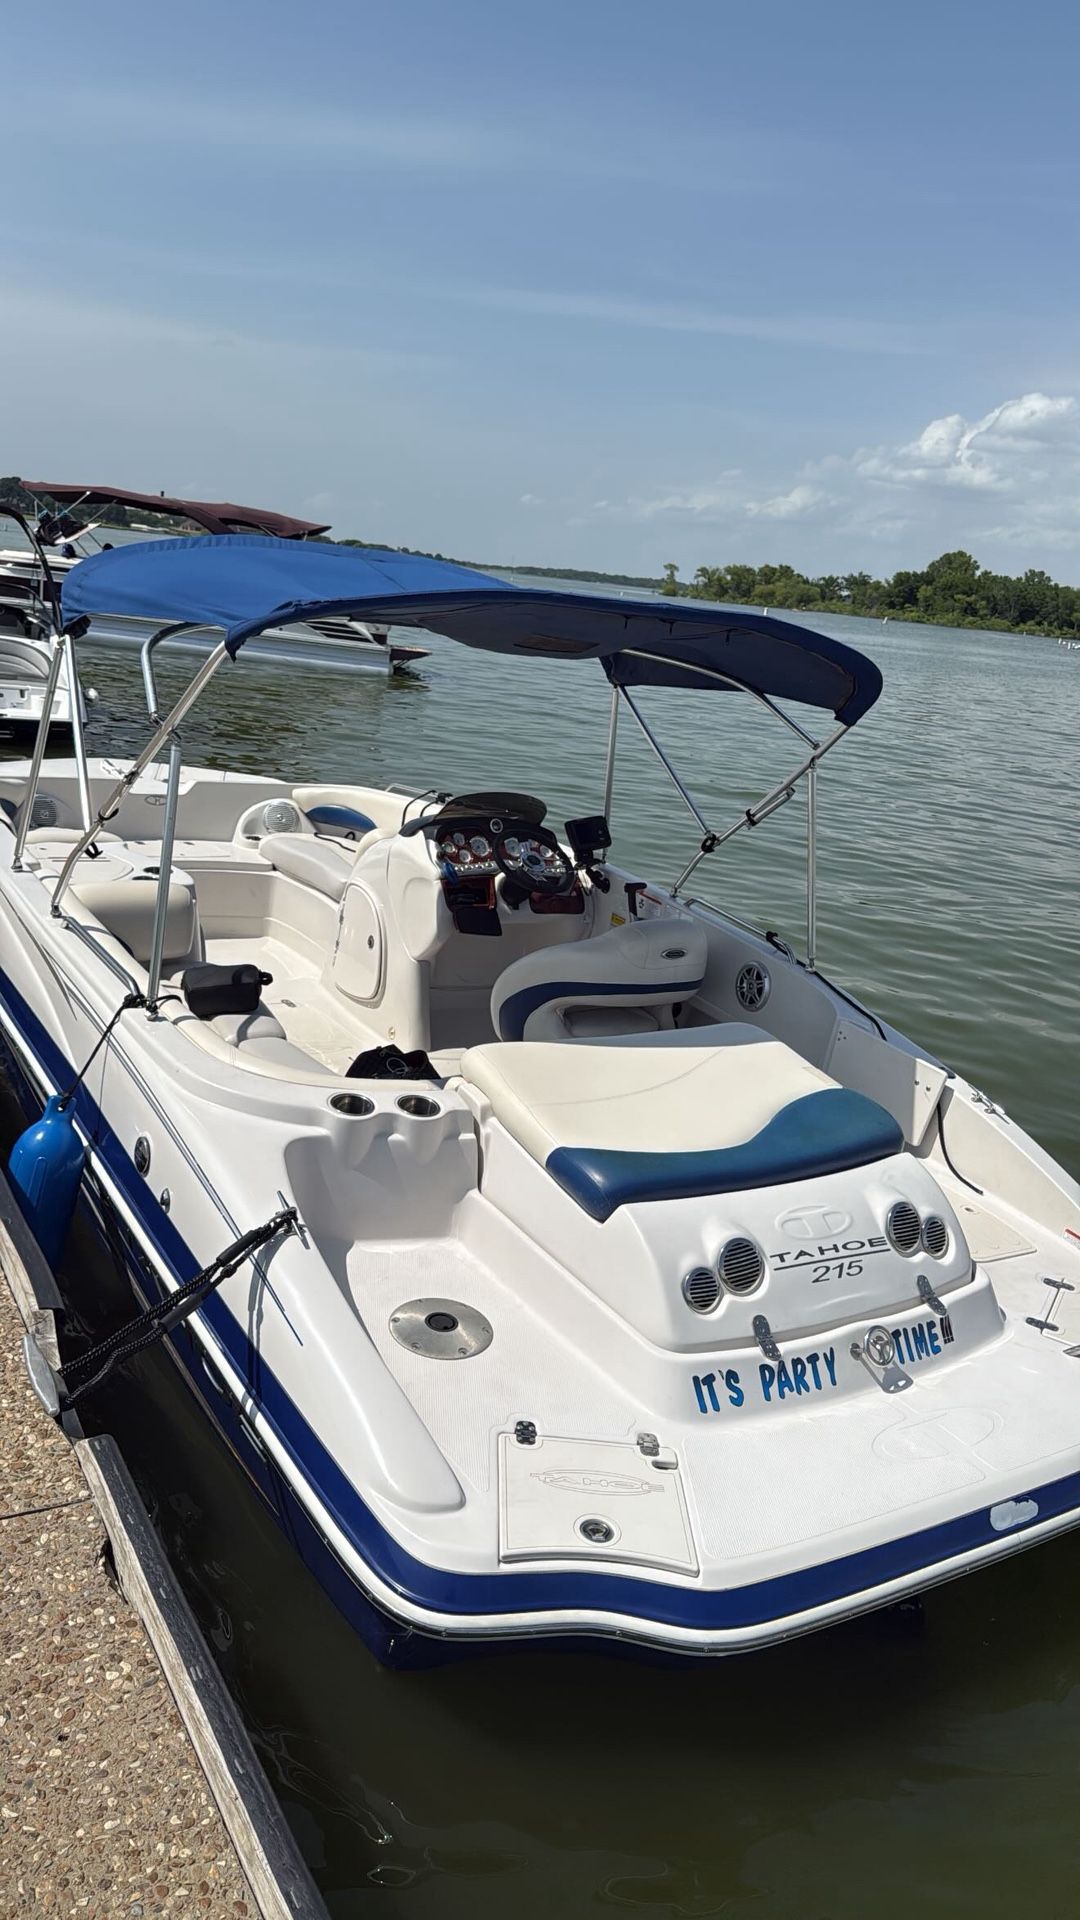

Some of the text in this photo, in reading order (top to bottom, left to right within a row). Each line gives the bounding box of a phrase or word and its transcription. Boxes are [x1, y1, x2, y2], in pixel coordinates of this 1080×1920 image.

[769, 1236, 888, 1263] TAHOE
[811, 1259, 863, 1284] 215
[692, 1369, 744, 1414] IT'S
[758, 1346, 837, 1402] PARTY
